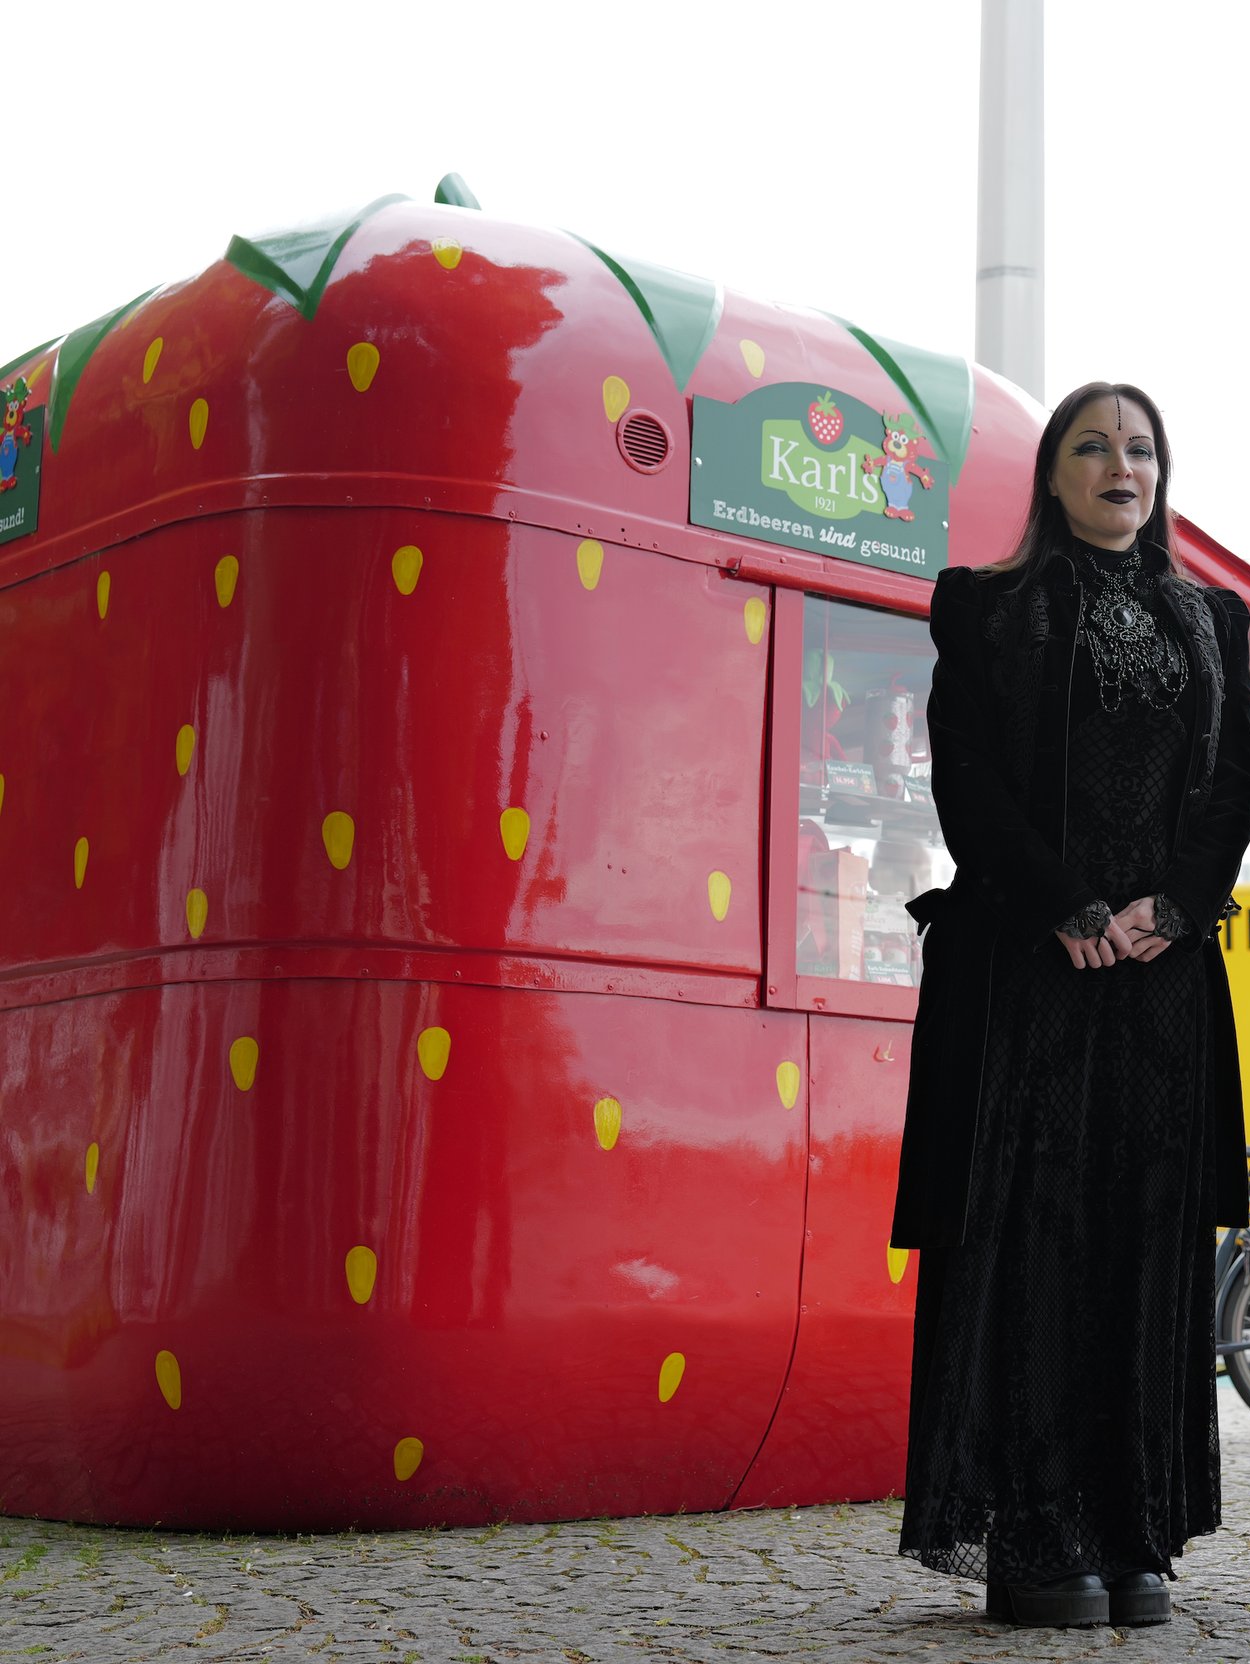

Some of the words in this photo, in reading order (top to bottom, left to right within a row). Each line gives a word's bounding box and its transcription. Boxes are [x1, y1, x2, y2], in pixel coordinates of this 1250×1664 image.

[768, 435, 879, 504] Karls
[0, 507, 25, 532] sund!
[814, 495, 836, 513] 1921
[713, 499, 815, 540] Erdbeeren
[819, 526, 856, 549] sind
[860, 538, 926, 566] gesund!
